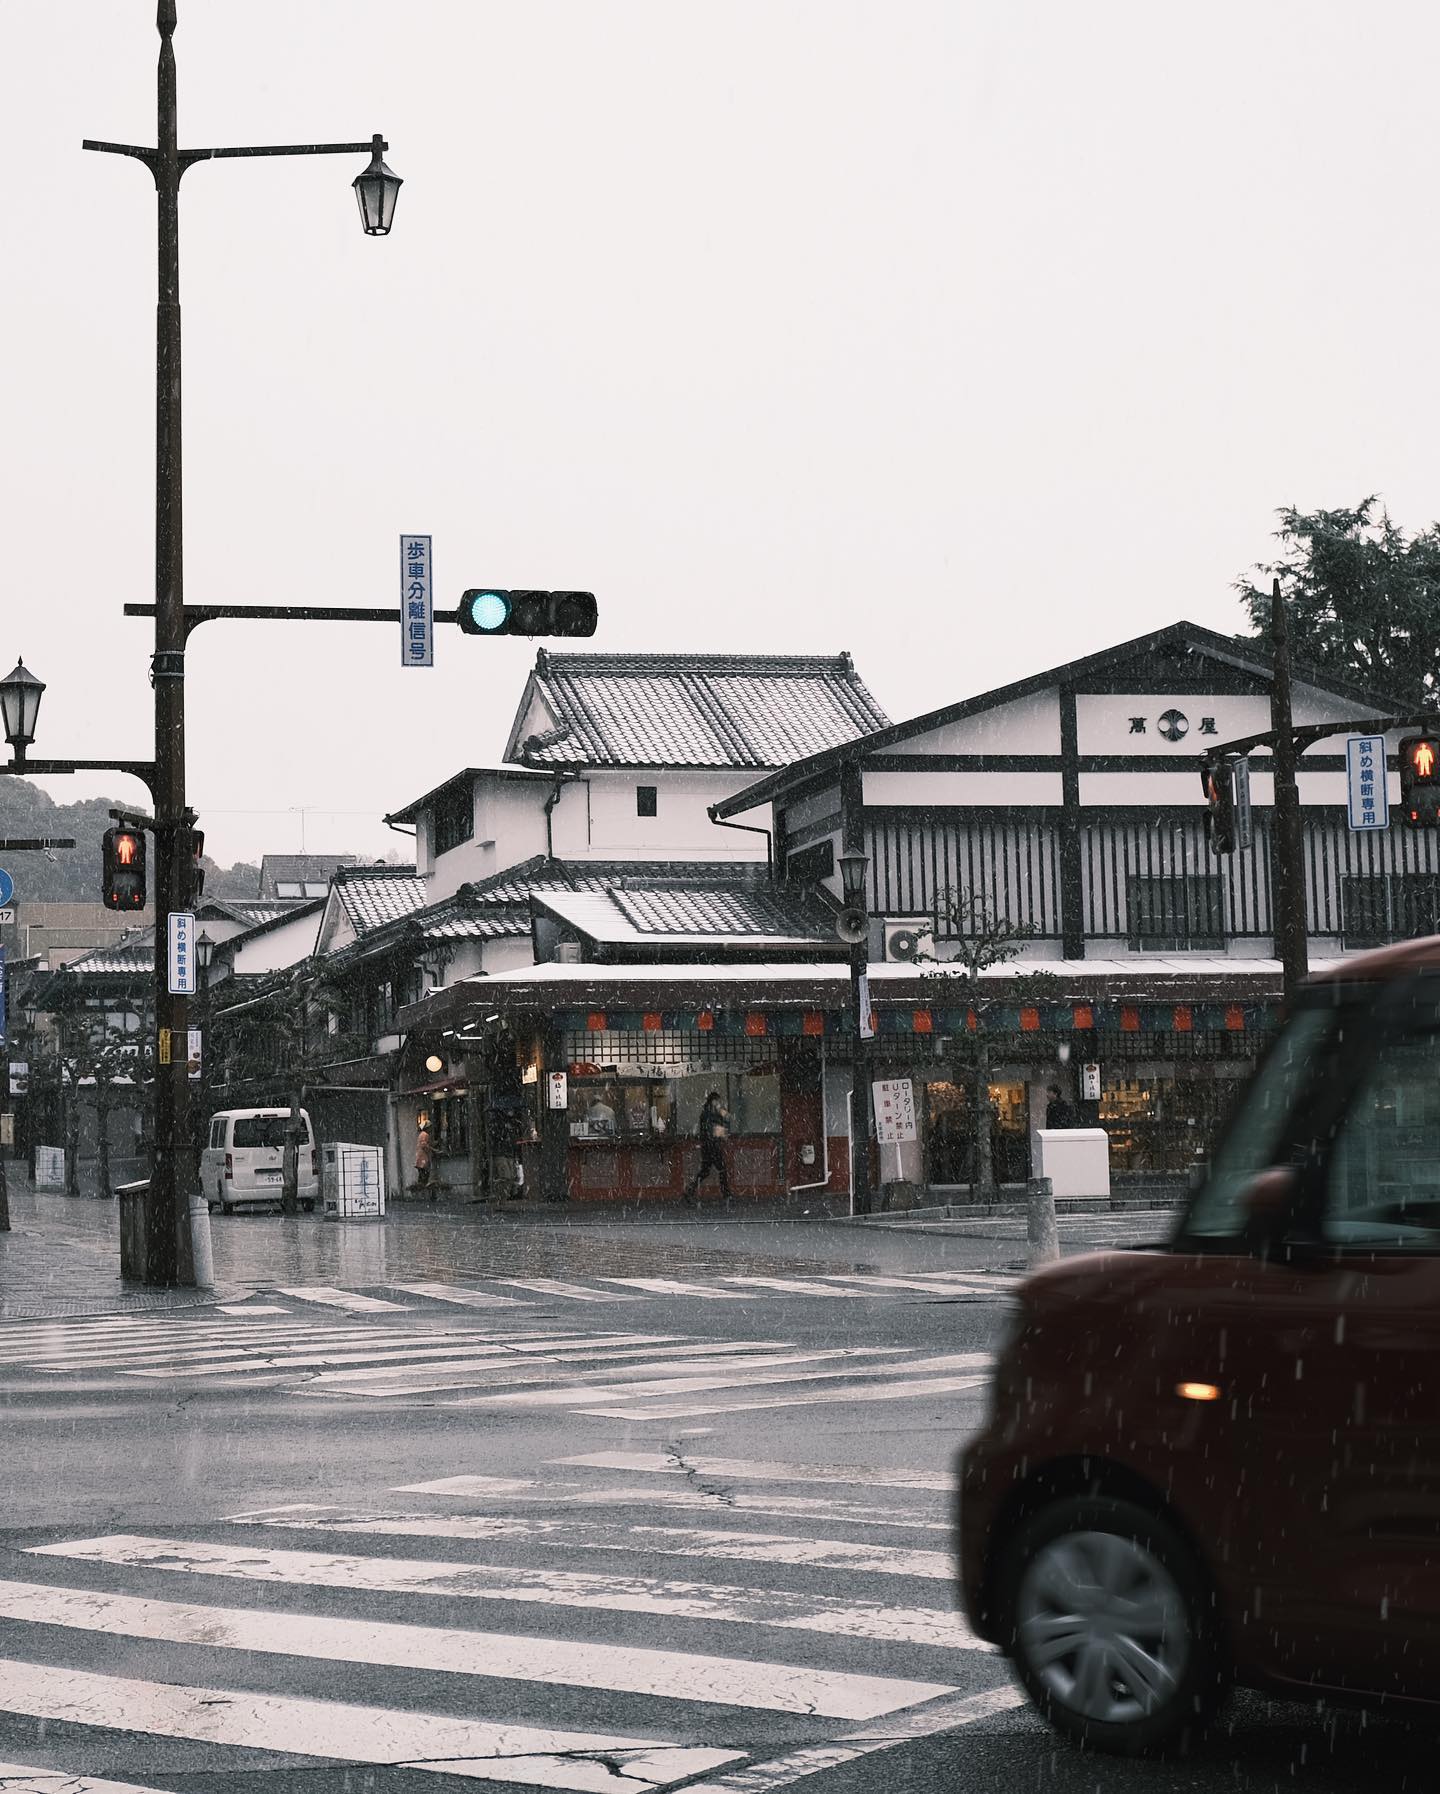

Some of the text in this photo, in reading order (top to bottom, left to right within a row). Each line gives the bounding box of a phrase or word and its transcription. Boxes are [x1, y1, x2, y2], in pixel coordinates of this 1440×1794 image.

[407, 541, 427, 661] 歩車分離信号
[1198, 717, 1218, 735] 屋
[1358, 740, 1376, 825] 斜め横断専用
[176, 917, 187, 990] 斜め横断専用
[892, 1083, 905, 1139] Uターン禁止
[901, 1082, 913, 1130] ロータリー内
